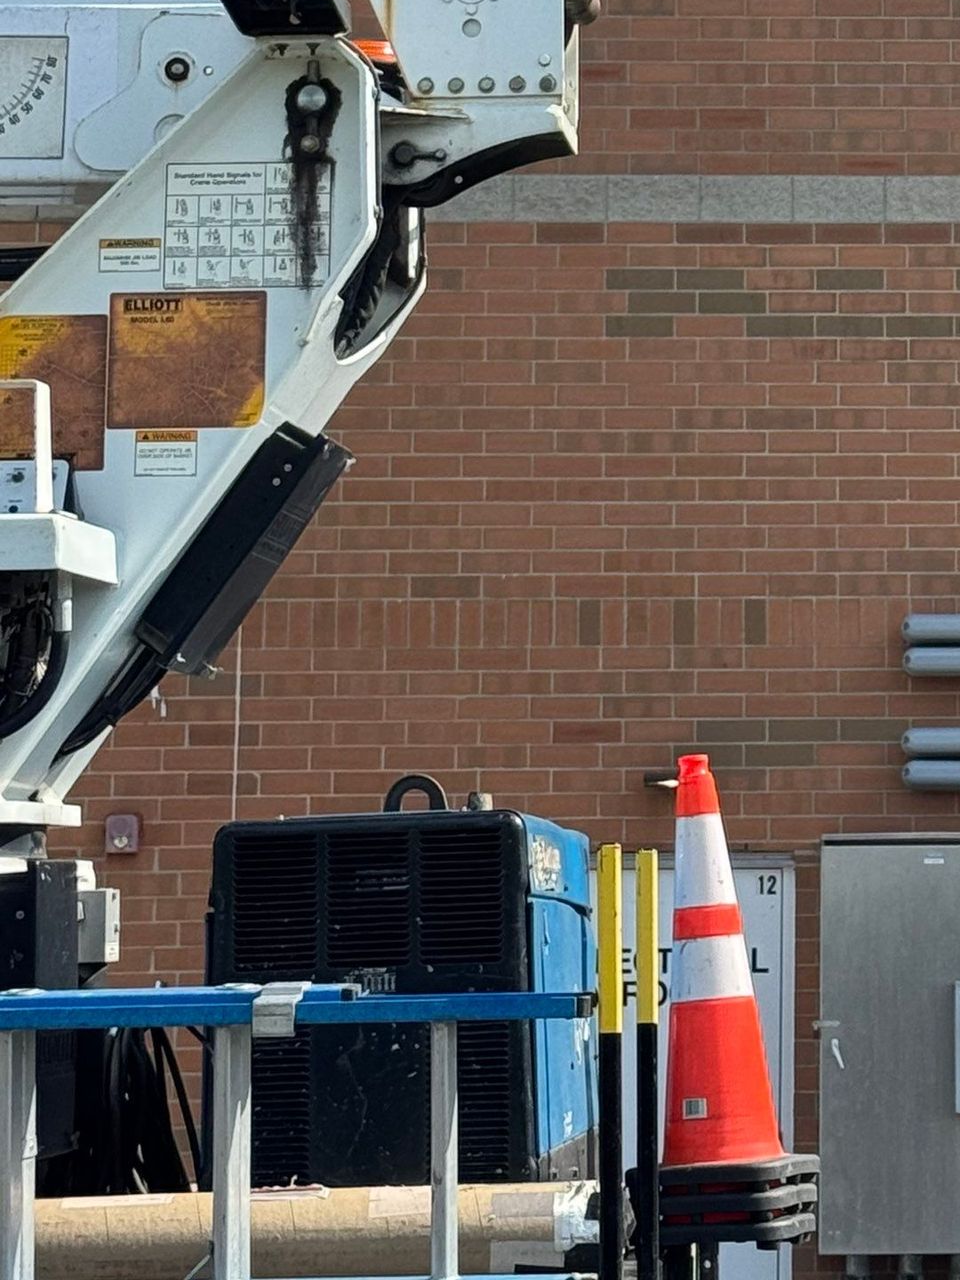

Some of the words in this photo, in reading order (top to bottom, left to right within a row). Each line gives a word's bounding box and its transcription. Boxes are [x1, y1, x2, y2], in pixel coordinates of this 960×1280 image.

[124, 298, 181, 312] ELLIOTT
[130, 316, 159, 324] MODEL
[151, 431, 193, 440] WARNING
[758, 875, 777, 895] 12
